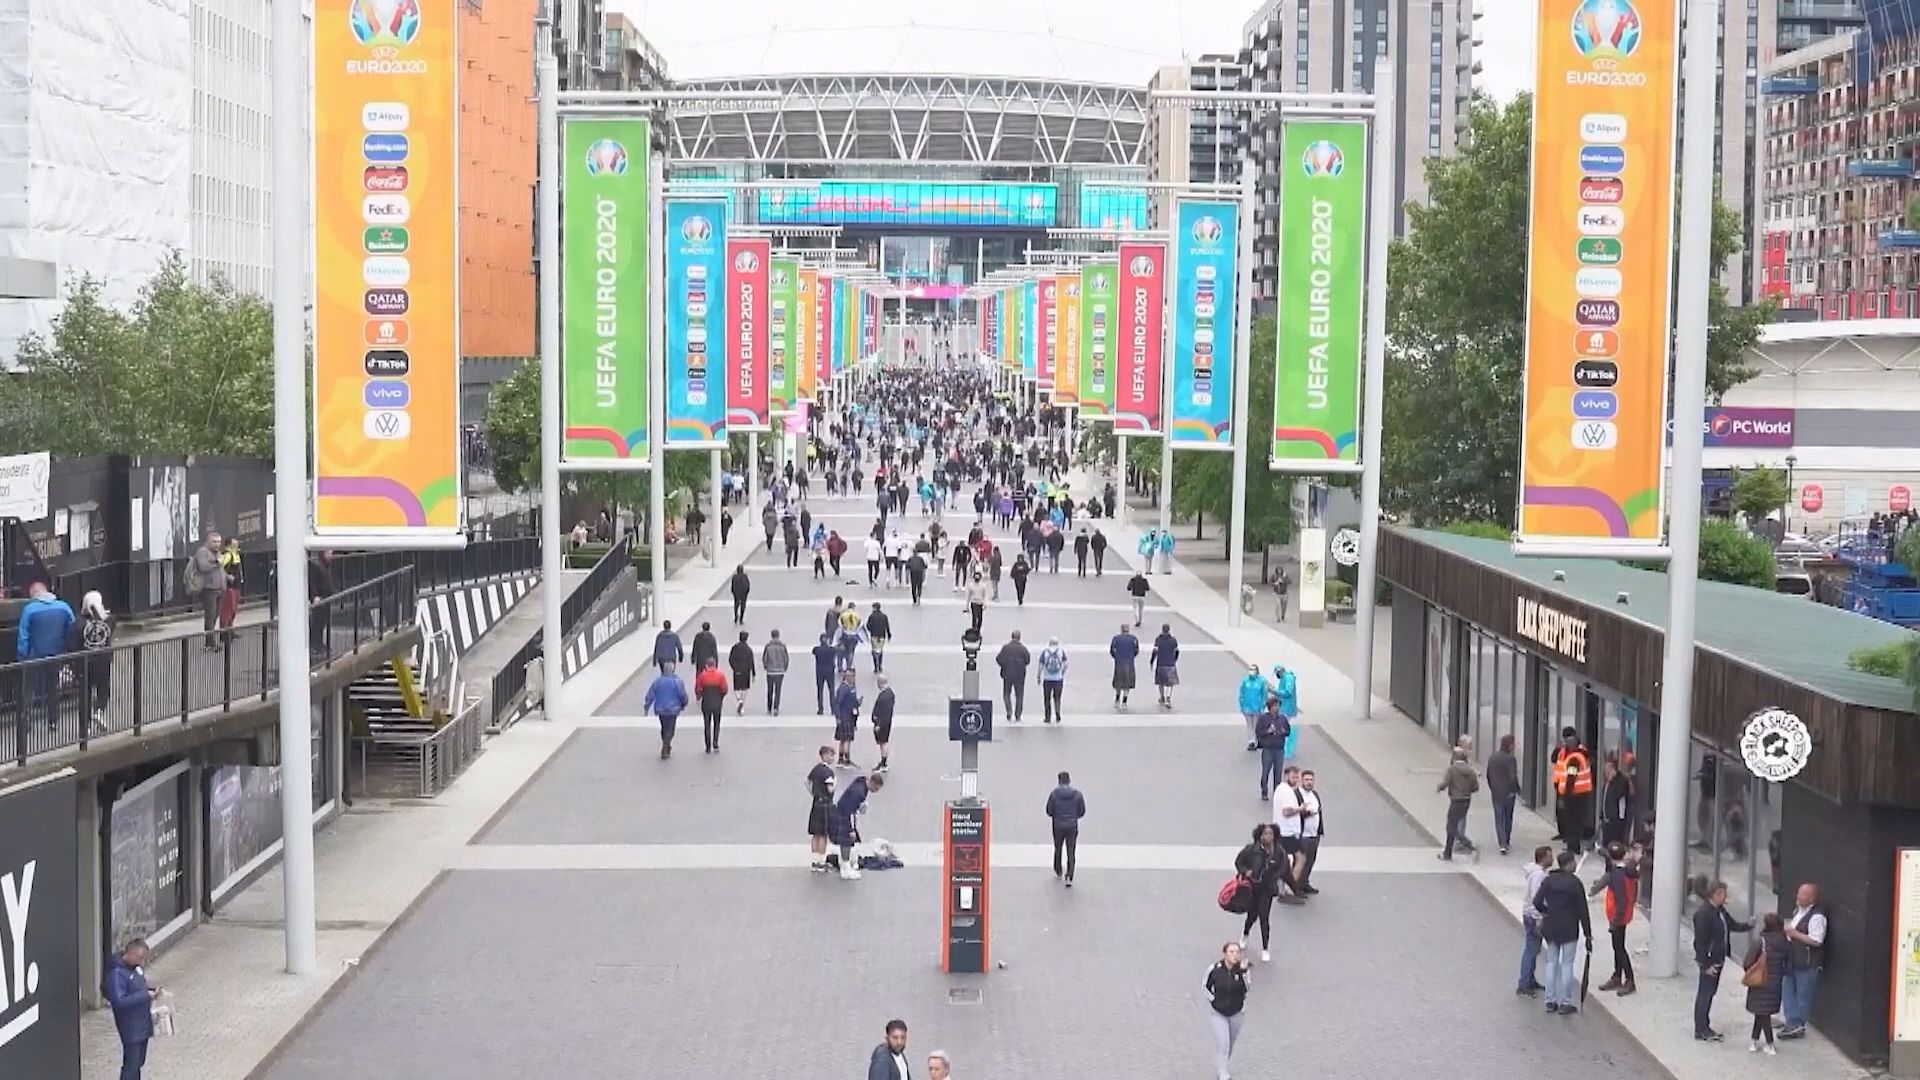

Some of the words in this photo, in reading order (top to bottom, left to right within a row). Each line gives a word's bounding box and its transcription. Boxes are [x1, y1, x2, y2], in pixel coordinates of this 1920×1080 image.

[368, 203, 402, 216] FedEx
[1583, 214, 1617, 226] FedEx
[368, 294, 405, 305] QATAR
[597, 268, 616, 336] EURO
[1309, 269, 1330, 337] EURO
[1579, 304, 1616, 317] QATAR
[377, 359, 406, 369] TikTok
[597, 340, 616, 408] UEFA
[1307, 342, 1328, 409] UEFA
[1586, 370, 1615, 380] TikTok
[373, 388, 402, 398] vivo
[1580, 399, 1610, 410] vivo
[1733, 419, 1752, 434] PC
[1753, 419, 1791, 434] World
[952, 813, 971, 821] Hand
[0, 859, 39, 1014] Y.
